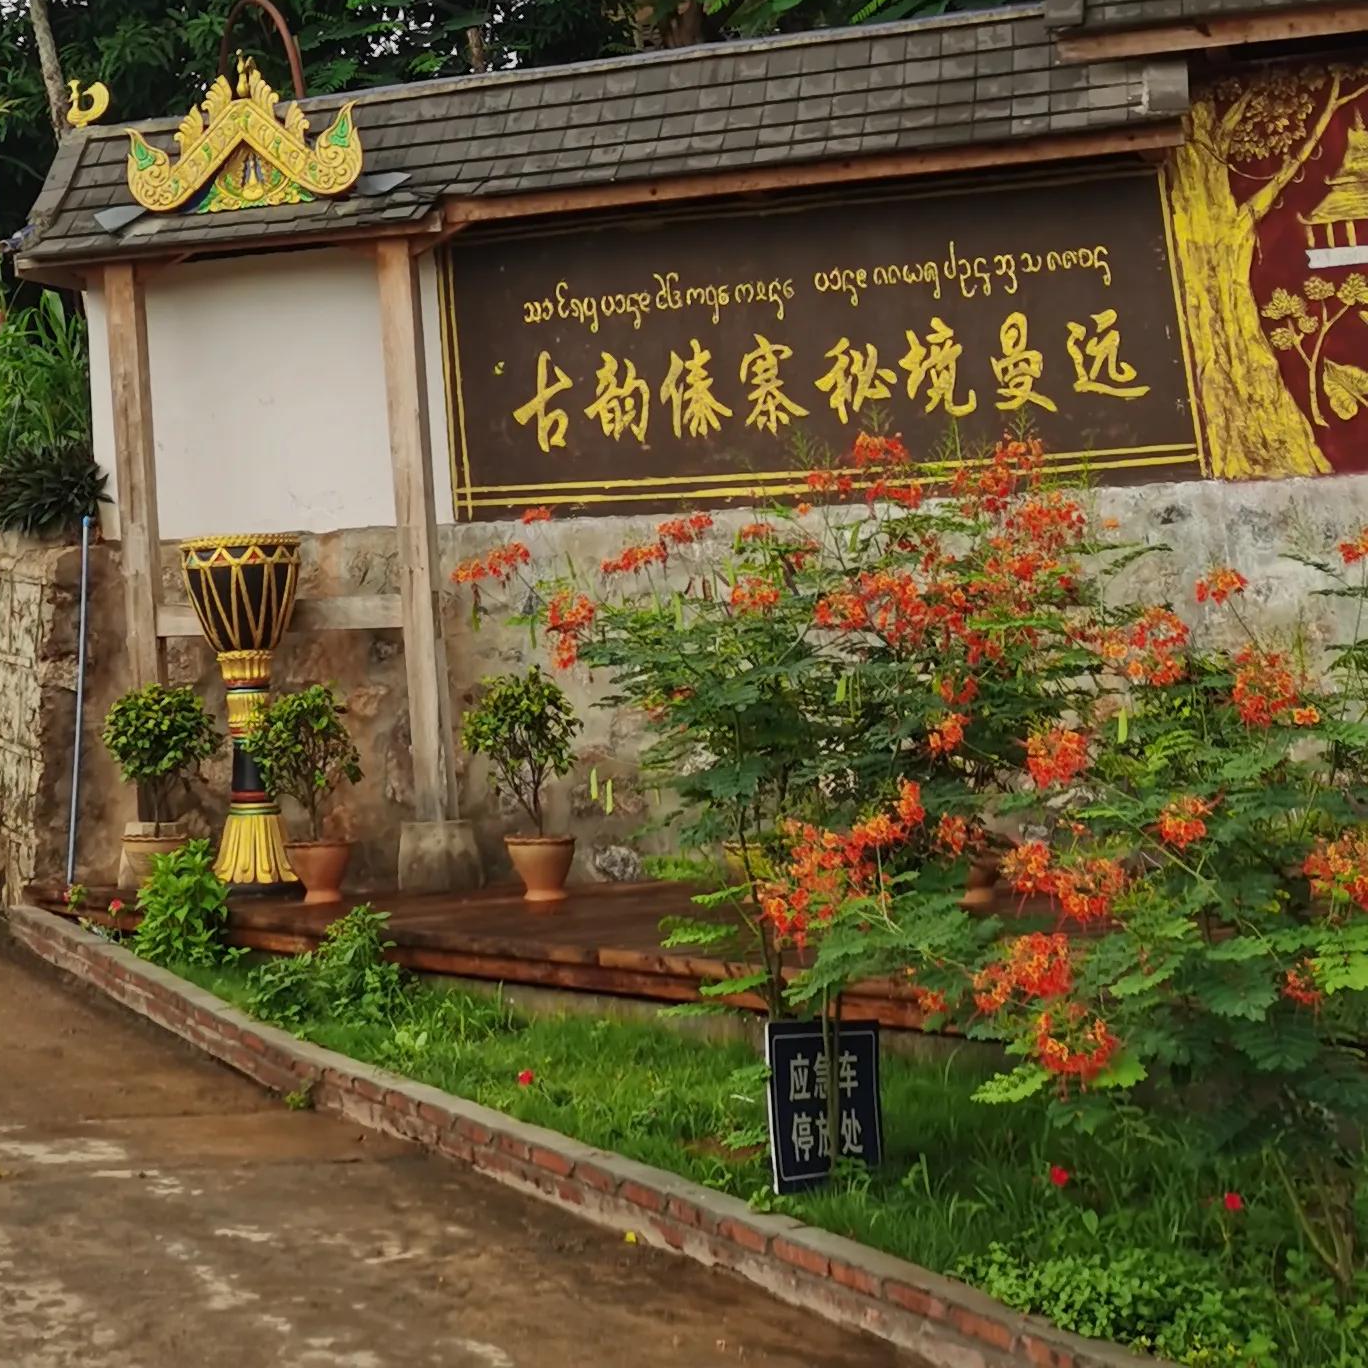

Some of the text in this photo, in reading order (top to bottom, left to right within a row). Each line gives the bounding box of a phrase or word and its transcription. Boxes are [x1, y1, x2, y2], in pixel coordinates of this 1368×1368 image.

[512, 308, 1152, 453] 古韵傣寨秘境曼远
[789, 1050, 859, 1102] 应急车
